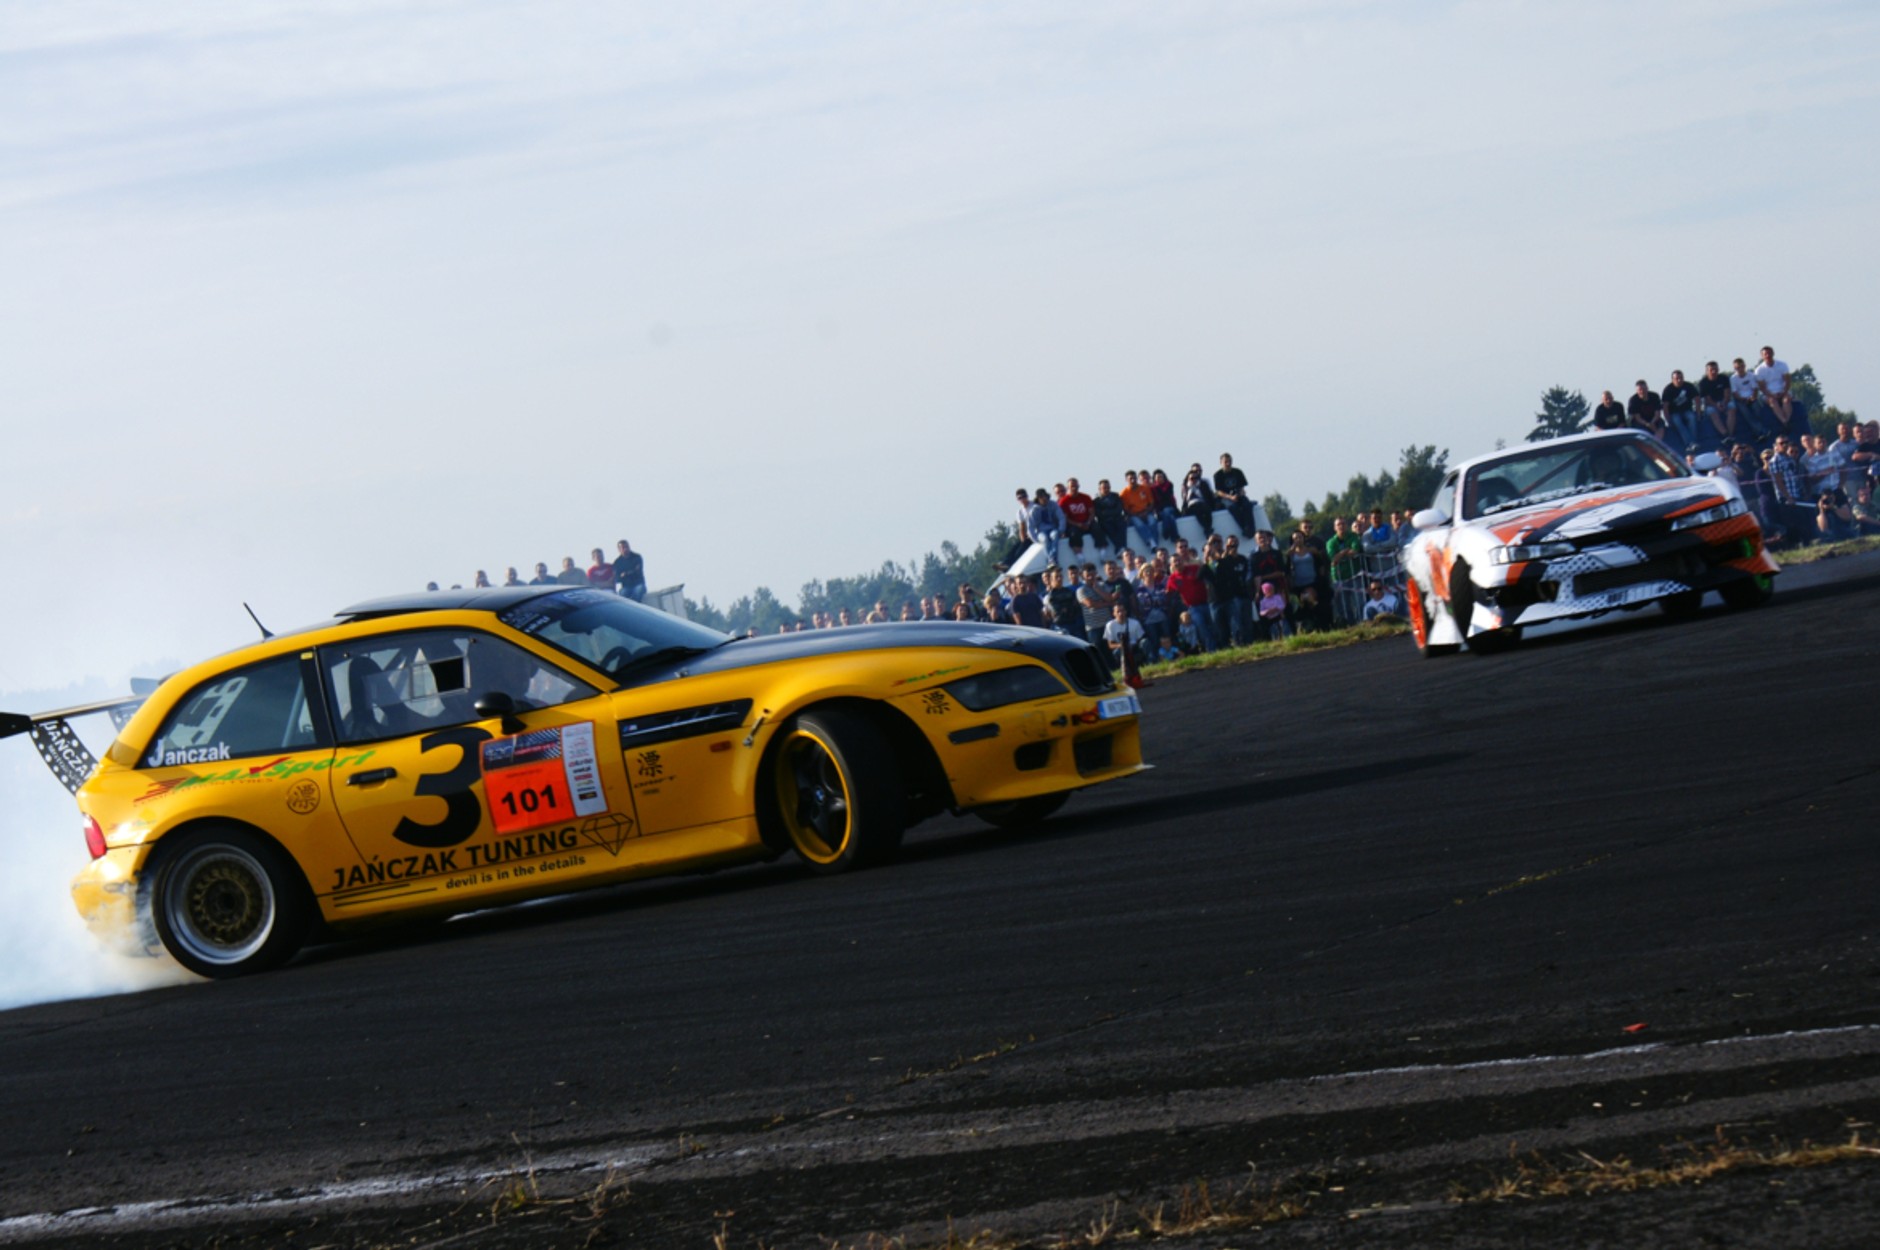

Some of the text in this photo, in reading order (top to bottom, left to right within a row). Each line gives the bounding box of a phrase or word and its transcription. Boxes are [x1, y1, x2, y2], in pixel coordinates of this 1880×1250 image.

[147, 738, 231, 767] Jańczak
[392, 726, 494, 848] 3
[501, 785, 557, 816] 101
[332, 826, 578, 890] JAŃCZAK TUNING
[445, 854, 586, 889] devil is in the details
